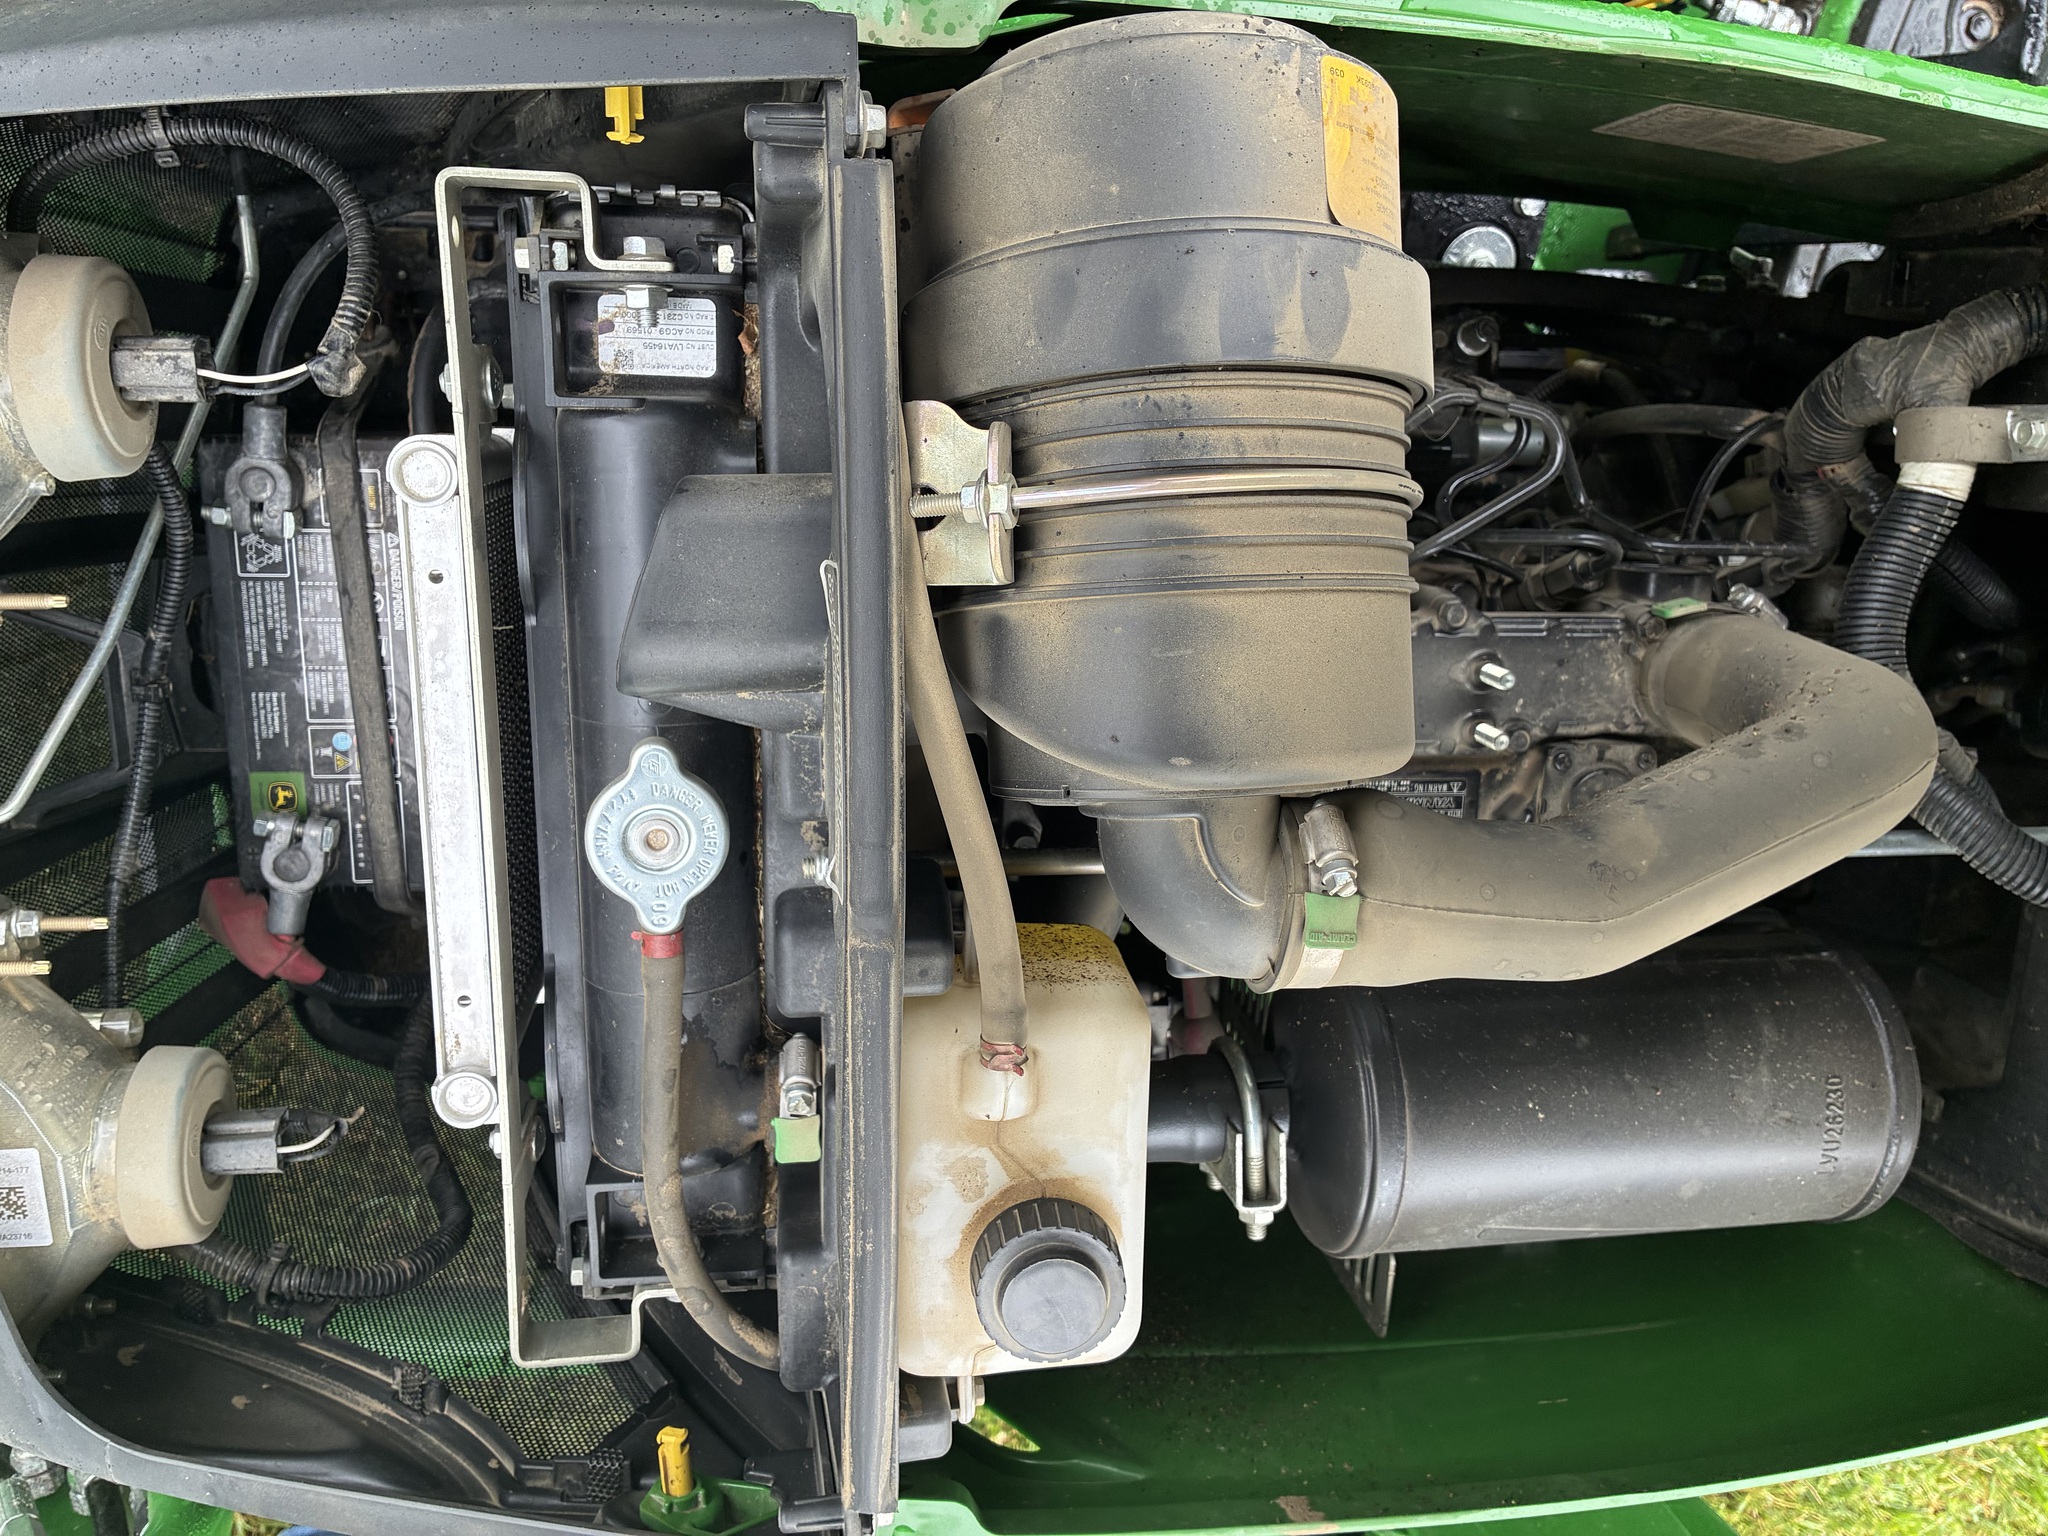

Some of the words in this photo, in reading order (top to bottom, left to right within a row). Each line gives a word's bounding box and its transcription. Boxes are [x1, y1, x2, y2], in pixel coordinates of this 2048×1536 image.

[1329, 67, 1345, 79] 039
[642, 342, 684, 351] LVA16455
[682, 858, 712, 889] OPEN
[655, 879, 682, 899] HOT
[1308, 930, 1357, 944] CLAMP-AID
